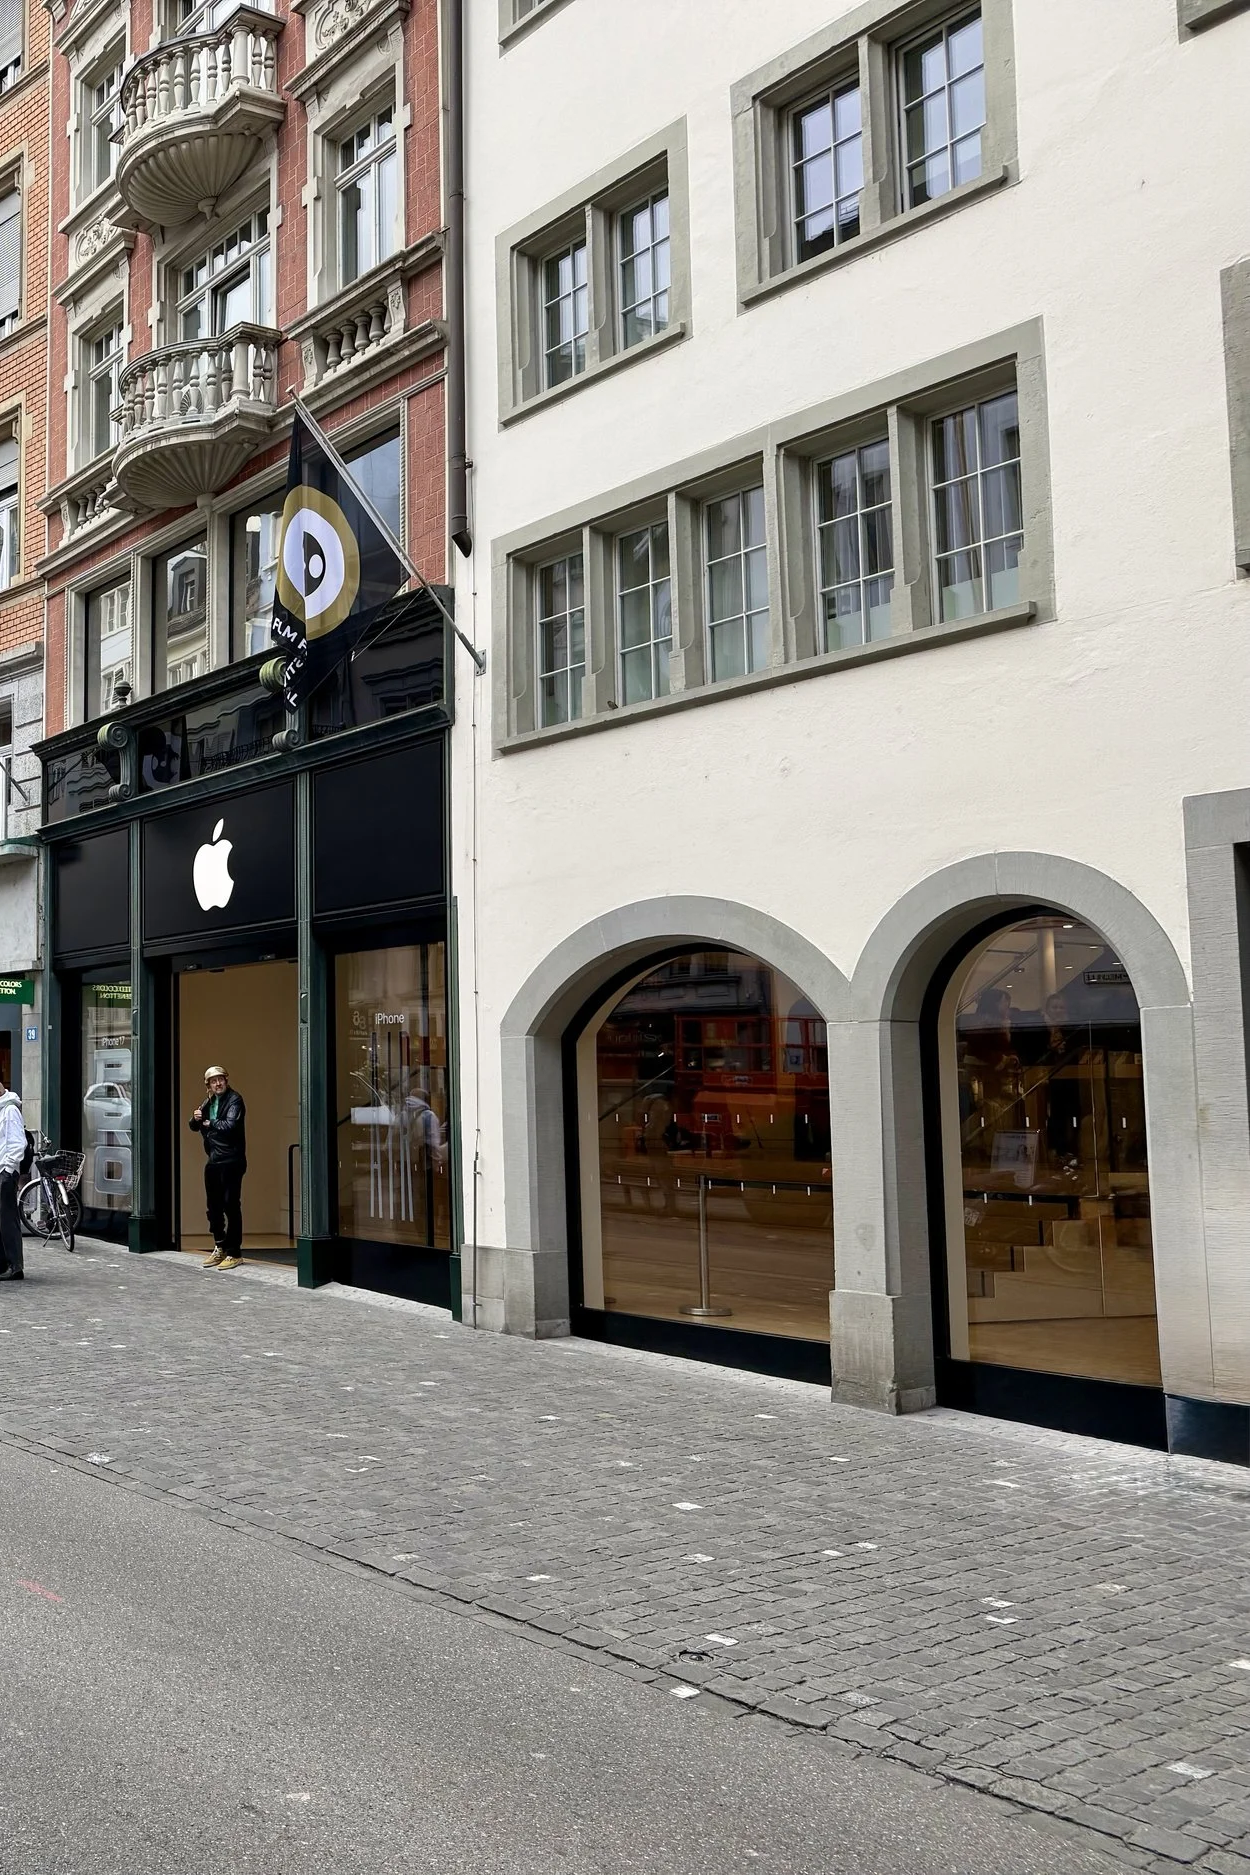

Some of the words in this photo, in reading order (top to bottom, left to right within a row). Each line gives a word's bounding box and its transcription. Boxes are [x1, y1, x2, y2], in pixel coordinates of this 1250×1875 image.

[0, 980, 22, 988] COLORS
[375, 1012, 405, 1025] iPhone
[27, 1029, 36, 1040] 39
[101, 1036, 119, 1047] iPhone
[118, 1036, 125, 1046] 17
